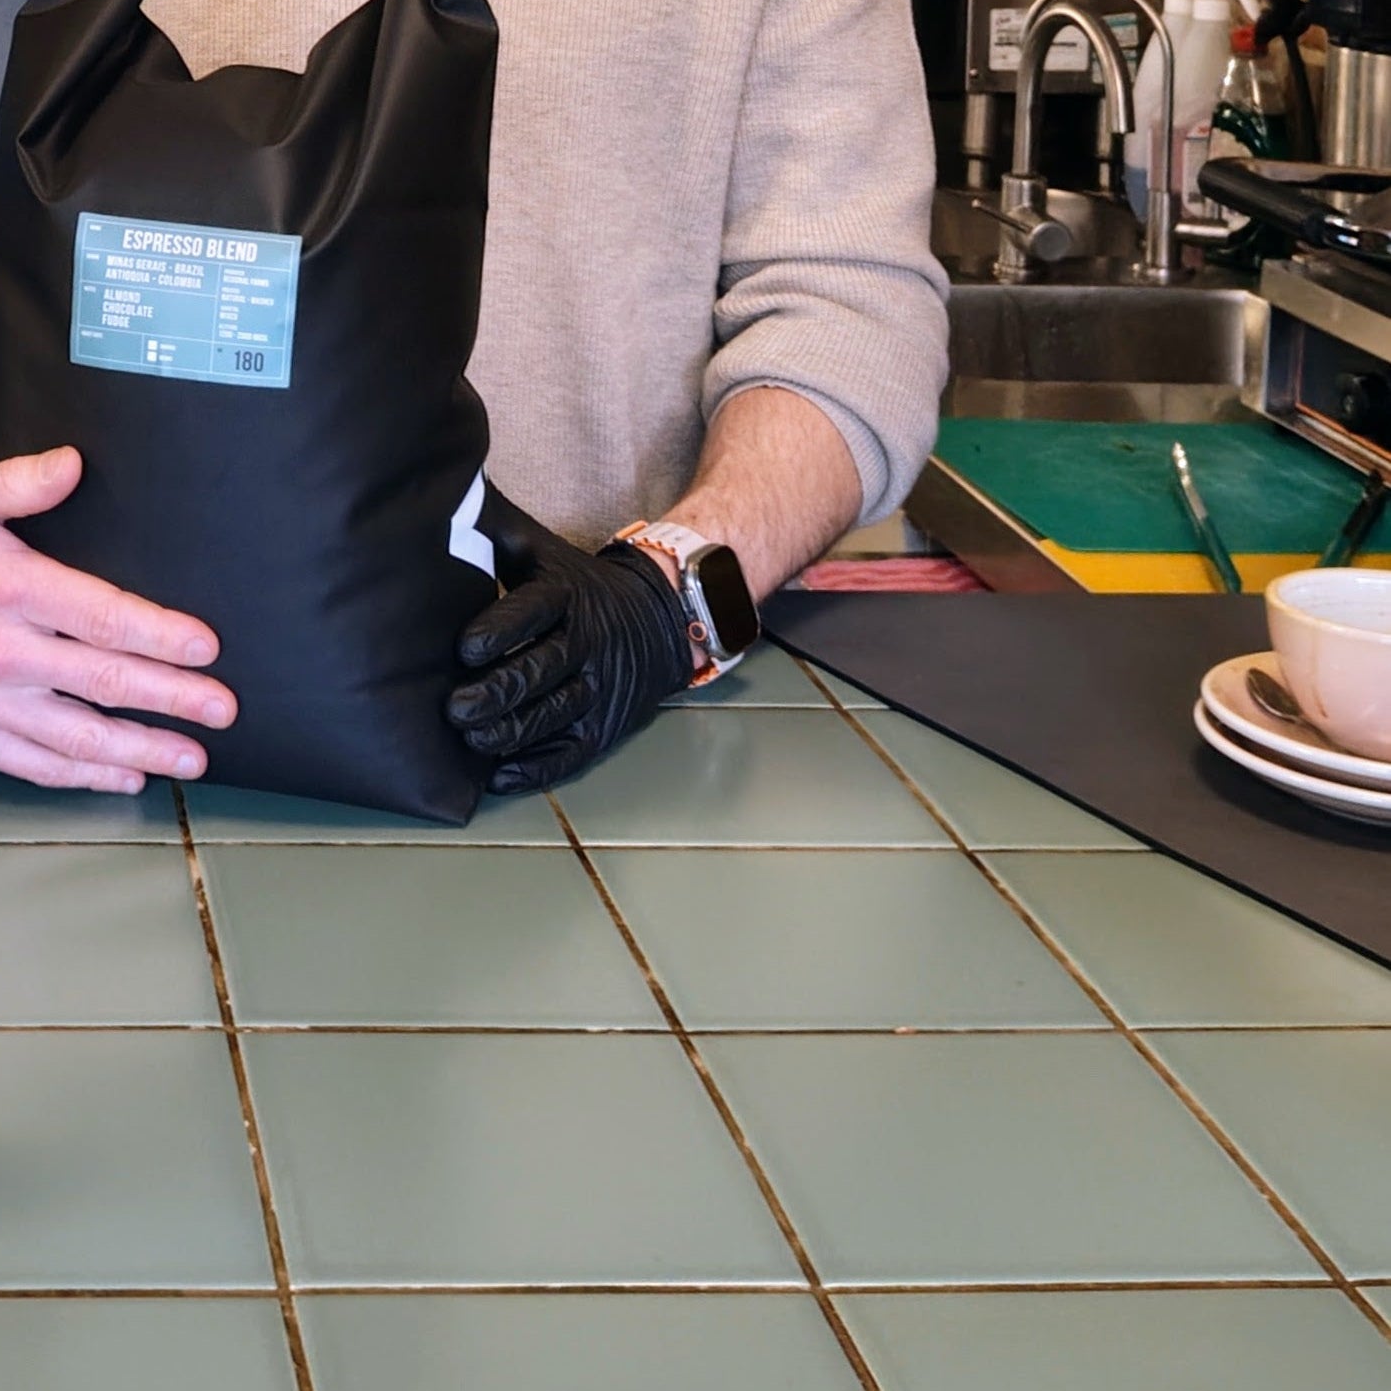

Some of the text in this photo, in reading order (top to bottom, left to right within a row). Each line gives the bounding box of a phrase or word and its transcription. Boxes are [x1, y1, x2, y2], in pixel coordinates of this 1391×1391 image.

[122, 229, 258, 262] ESPRESSO BLEND
[106, 254, 134, 269] MINAS
[135, 258, 167, 272] GERAIS
[174, 262, 204, 276] BRAZIL
[158, 274, 202, 289] COLOMBIA
[103, 289, 141, 304] ALMOND
[102, 301, 154, 318] CHOCOLATE
[101, 313, 130, 328] FUDGE
[234, 350, 265, 372] 180
